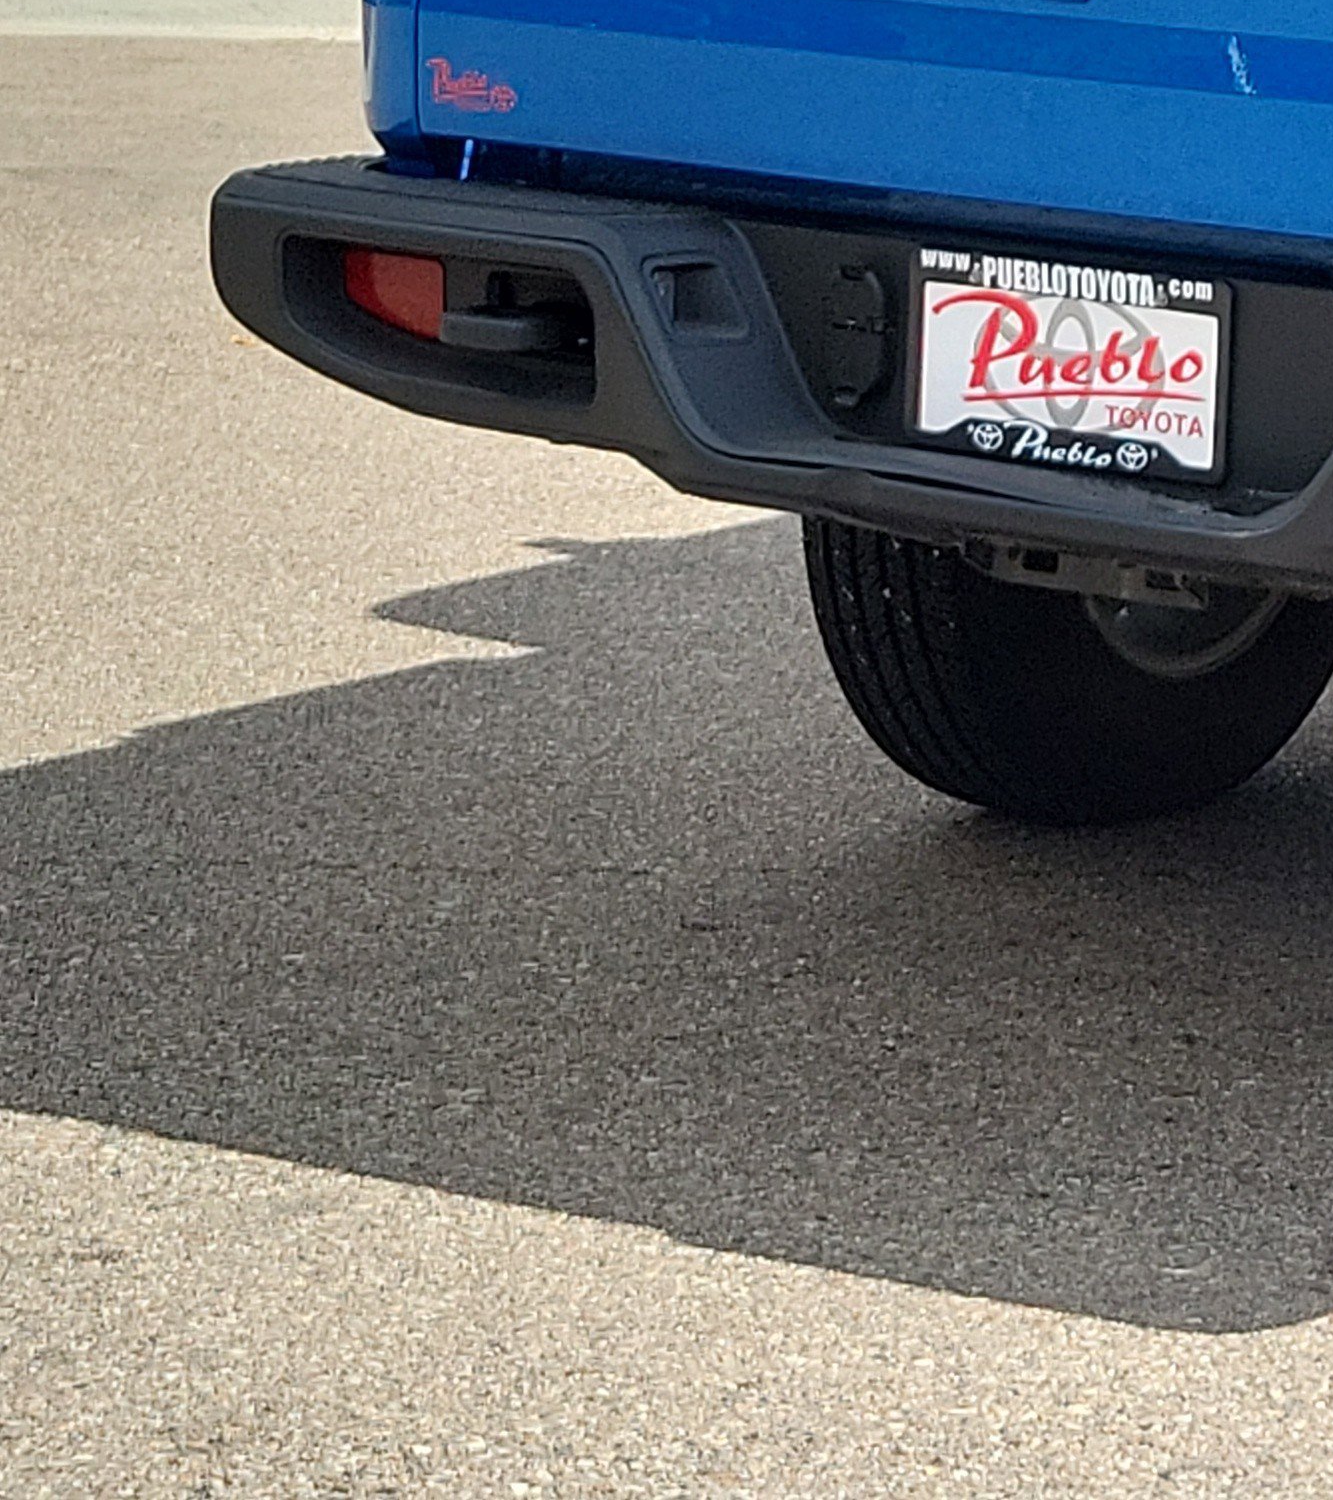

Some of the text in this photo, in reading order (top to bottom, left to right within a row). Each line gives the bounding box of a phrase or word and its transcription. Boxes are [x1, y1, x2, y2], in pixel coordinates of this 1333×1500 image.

[932, 289, 1204, 389] Pueblo
[1004, 420, 1112, 468] Pueblo
[1105, 404, 1204, 438] TOYOTA
